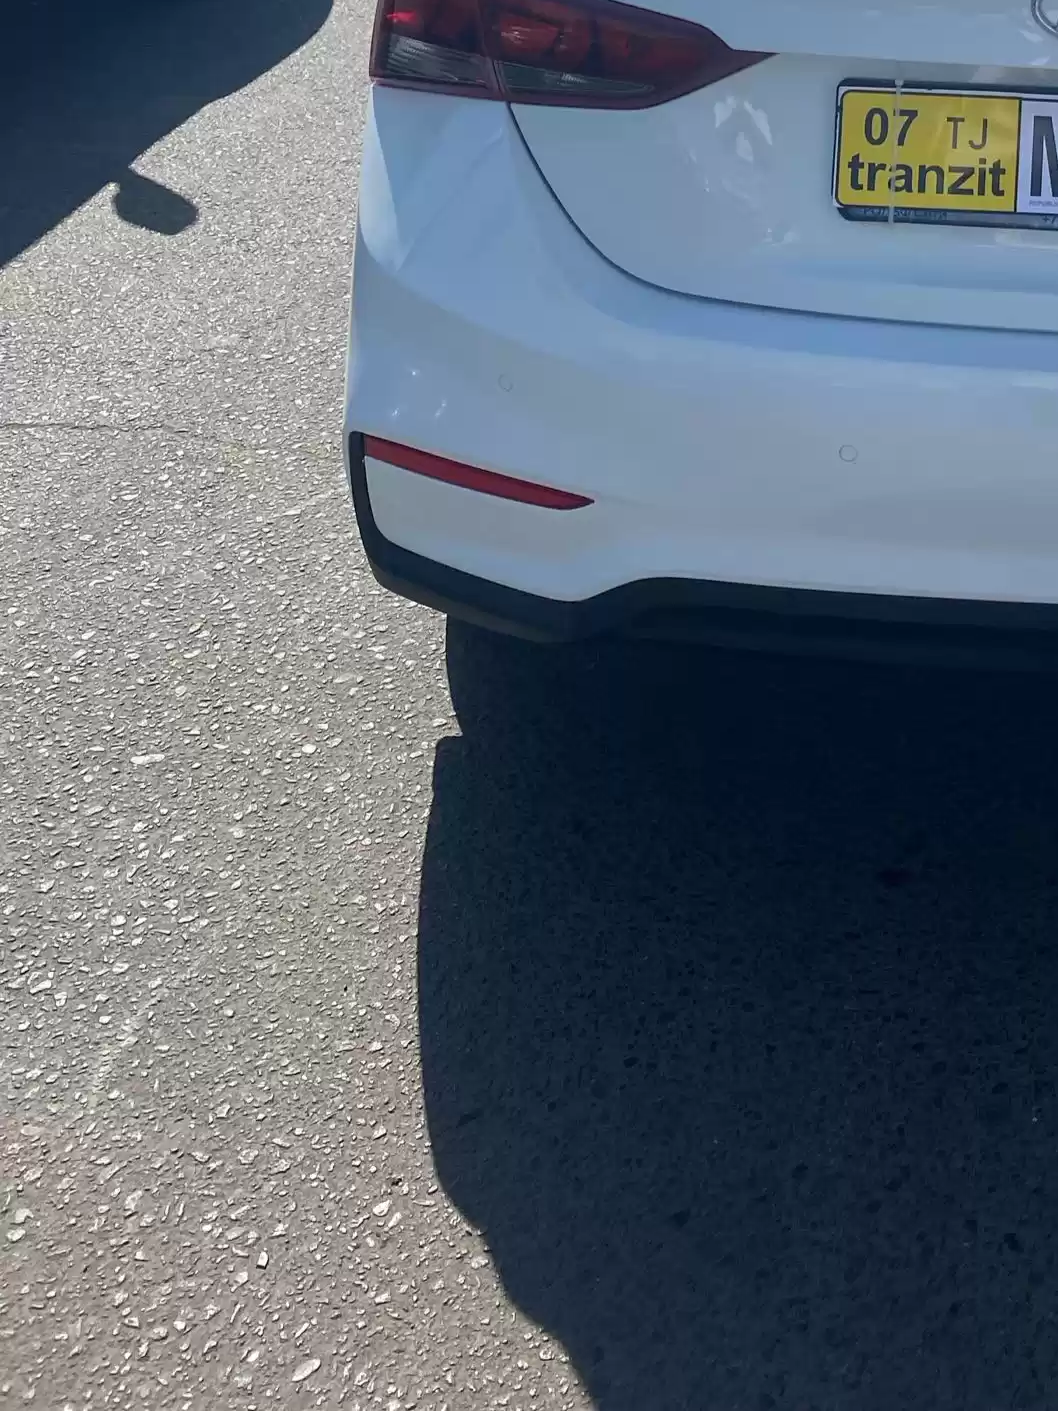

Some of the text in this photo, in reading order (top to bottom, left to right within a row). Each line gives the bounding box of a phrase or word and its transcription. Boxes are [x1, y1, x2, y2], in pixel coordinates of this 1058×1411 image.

[864, 107, 988, 150] 07 TJ
[848, 153, 1006, 197] tranzit
